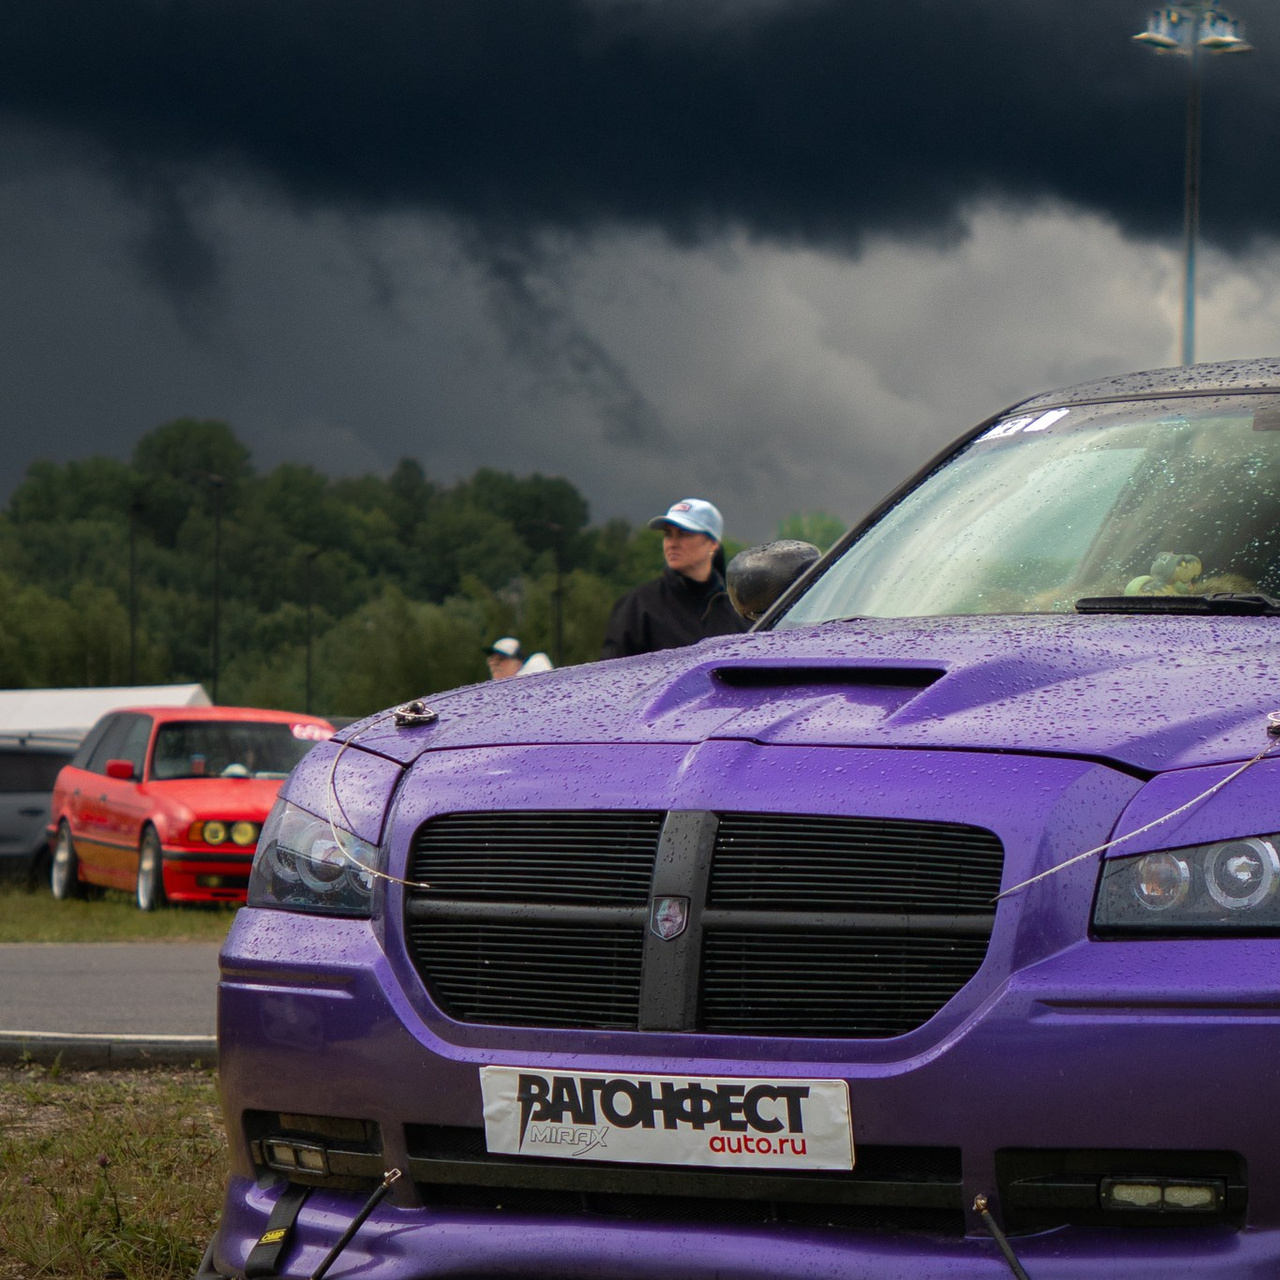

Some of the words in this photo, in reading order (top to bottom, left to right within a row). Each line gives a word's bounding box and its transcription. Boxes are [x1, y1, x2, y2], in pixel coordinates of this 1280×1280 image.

[517, 1074, 809, 1152] ВАГОНФЕСТ
[530, 1125, 609, 1156] MIRAX
[709, 1135, 806, 1154] auto.ru
